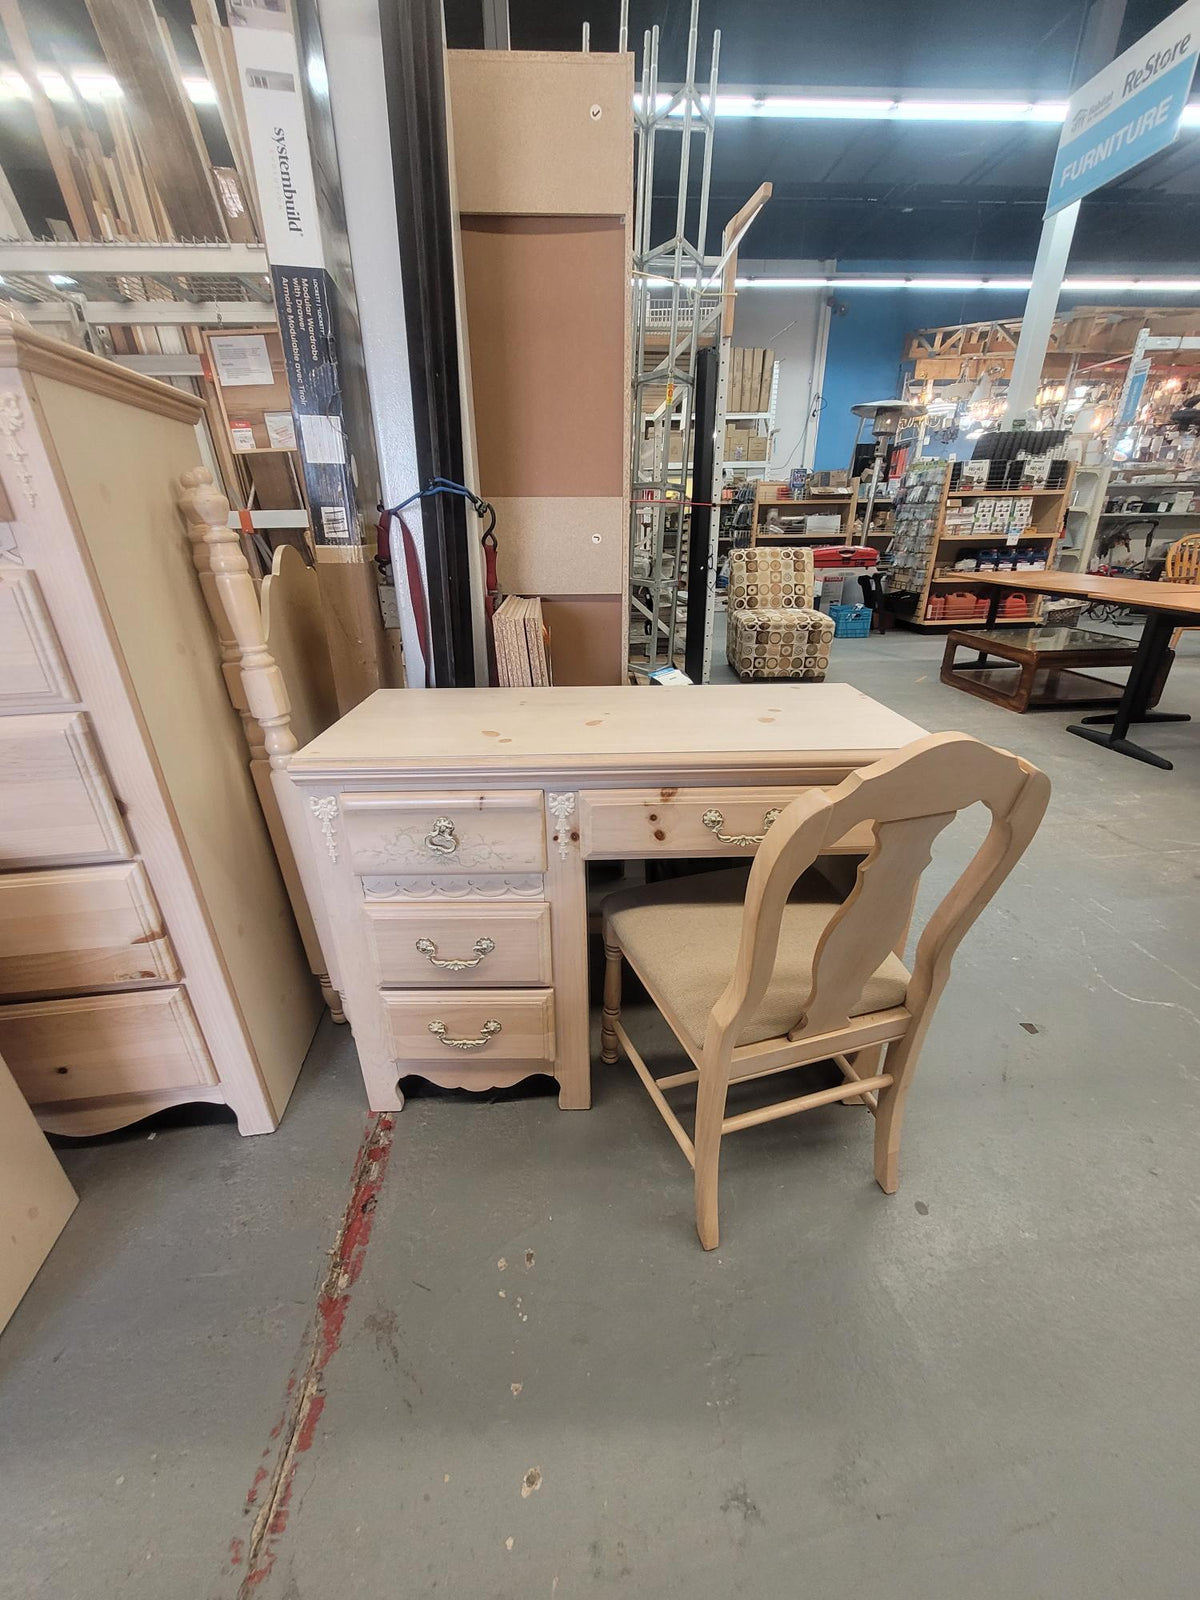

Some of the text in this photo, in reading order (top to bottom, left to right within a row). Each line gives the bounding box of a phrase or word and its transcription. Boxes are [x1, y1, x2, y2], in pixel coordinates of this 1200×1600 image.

[1122, 33, 1191, 98] ReStore
[271, 127, 303, 233] systembuild
[1059, 94, 1173, 189] FURNITURE
[292, 277, 306, 332] with Drawer
[301, 278, 319, 361] Modular Wardrobe
[312, 278, 321, 303] LOCKETT
[281, 276, 308, 407] Armoire Modulable avec Tiroir
